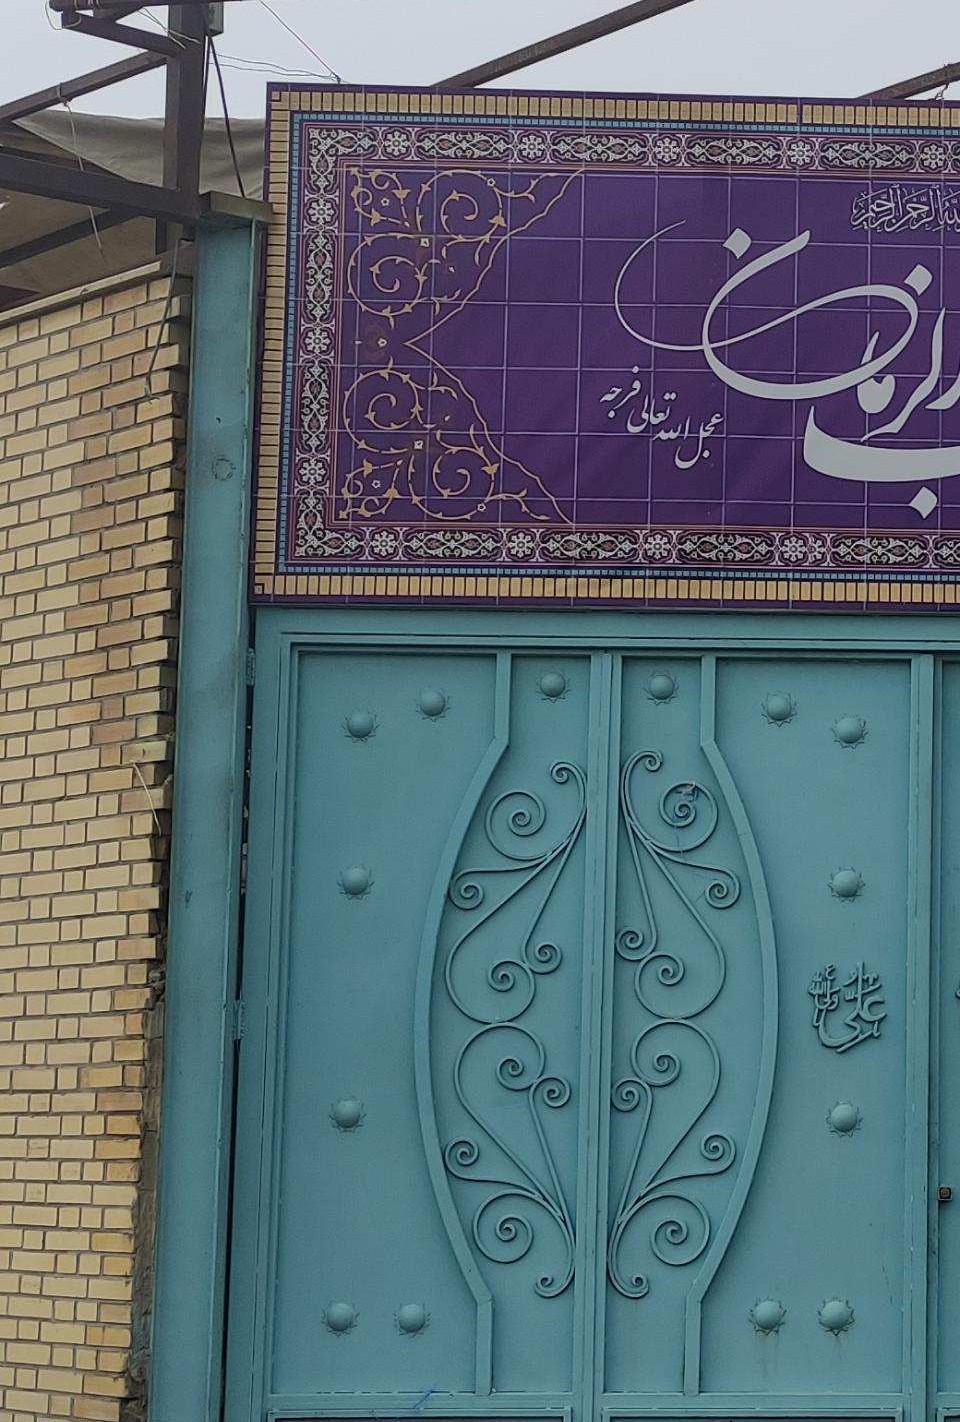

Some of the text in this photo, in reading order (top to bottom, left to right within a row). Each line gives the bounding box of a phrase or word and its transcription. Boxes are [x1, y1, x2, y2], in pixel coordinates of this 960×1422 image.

[599, 365, 724, 469] عجل الله تعالی فرجه
